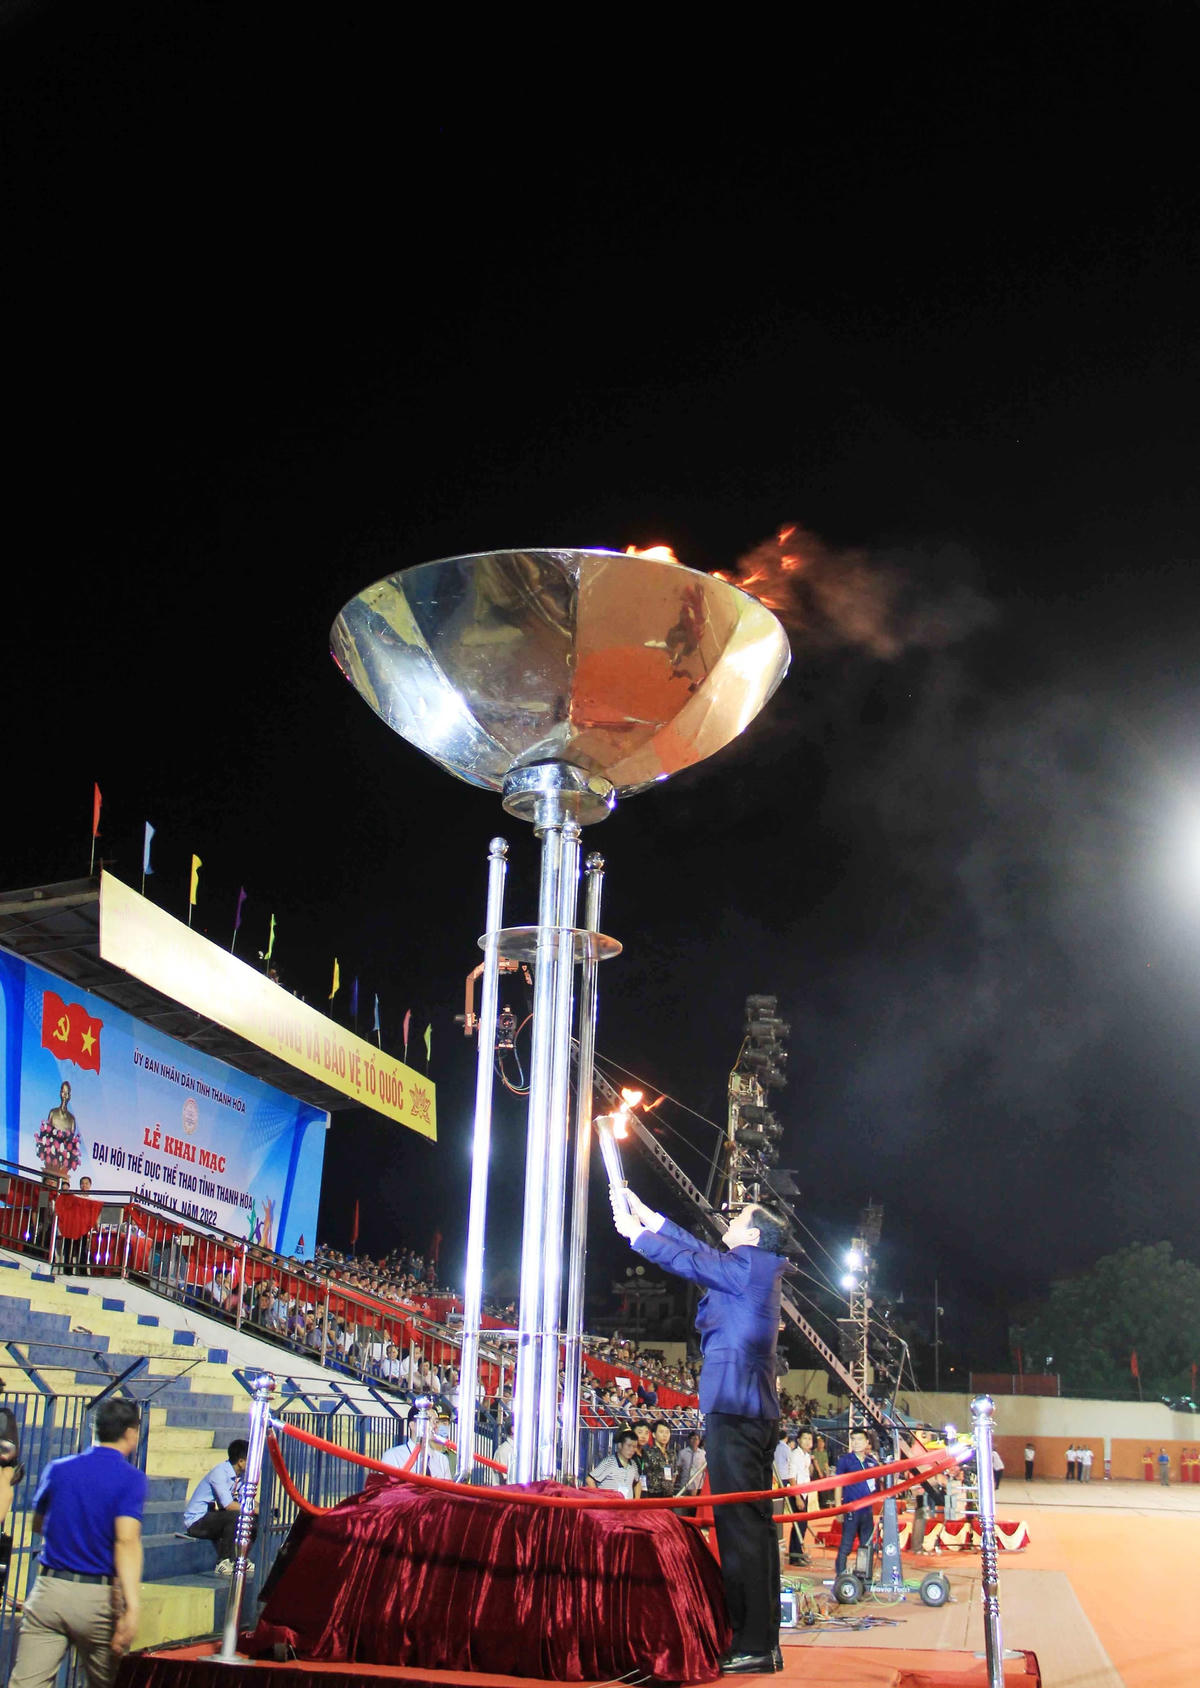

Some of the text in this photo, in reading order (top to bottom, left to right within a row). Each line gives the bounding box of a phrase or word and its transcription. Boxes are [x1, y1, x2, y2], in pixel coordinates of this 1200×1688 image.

[133, 1047, 144, 1067] ỦY
[144, 1057, 159, 1074] BAN
[160, 1064, 181, 1084] NHÂN
[181, 1072, 196, 1091] DÂN
[211, 1087, 232, 1107] THANH
[232, 1097, 246, 1114] HÓA
[304, 1024, 321, 1065] VÀ
[323, 1030, 347, 1079] BẢO
[348, 1048, 362, 1094] VỆ
[364, 1053, 376, 1095] TỔ
[378, 1067, 404, 1110] QUỐC
[92, 1142, 253, 1211] ĐẠI HỘI THỂ DỤC THỂ THAO TỈNH THANH HÓA
[143, 1123, 226, 1174] LỄ KHAI MẠC
[181, 1200, 199, 1220] NĂM
[199, 1207, 218, 1227] 2022
